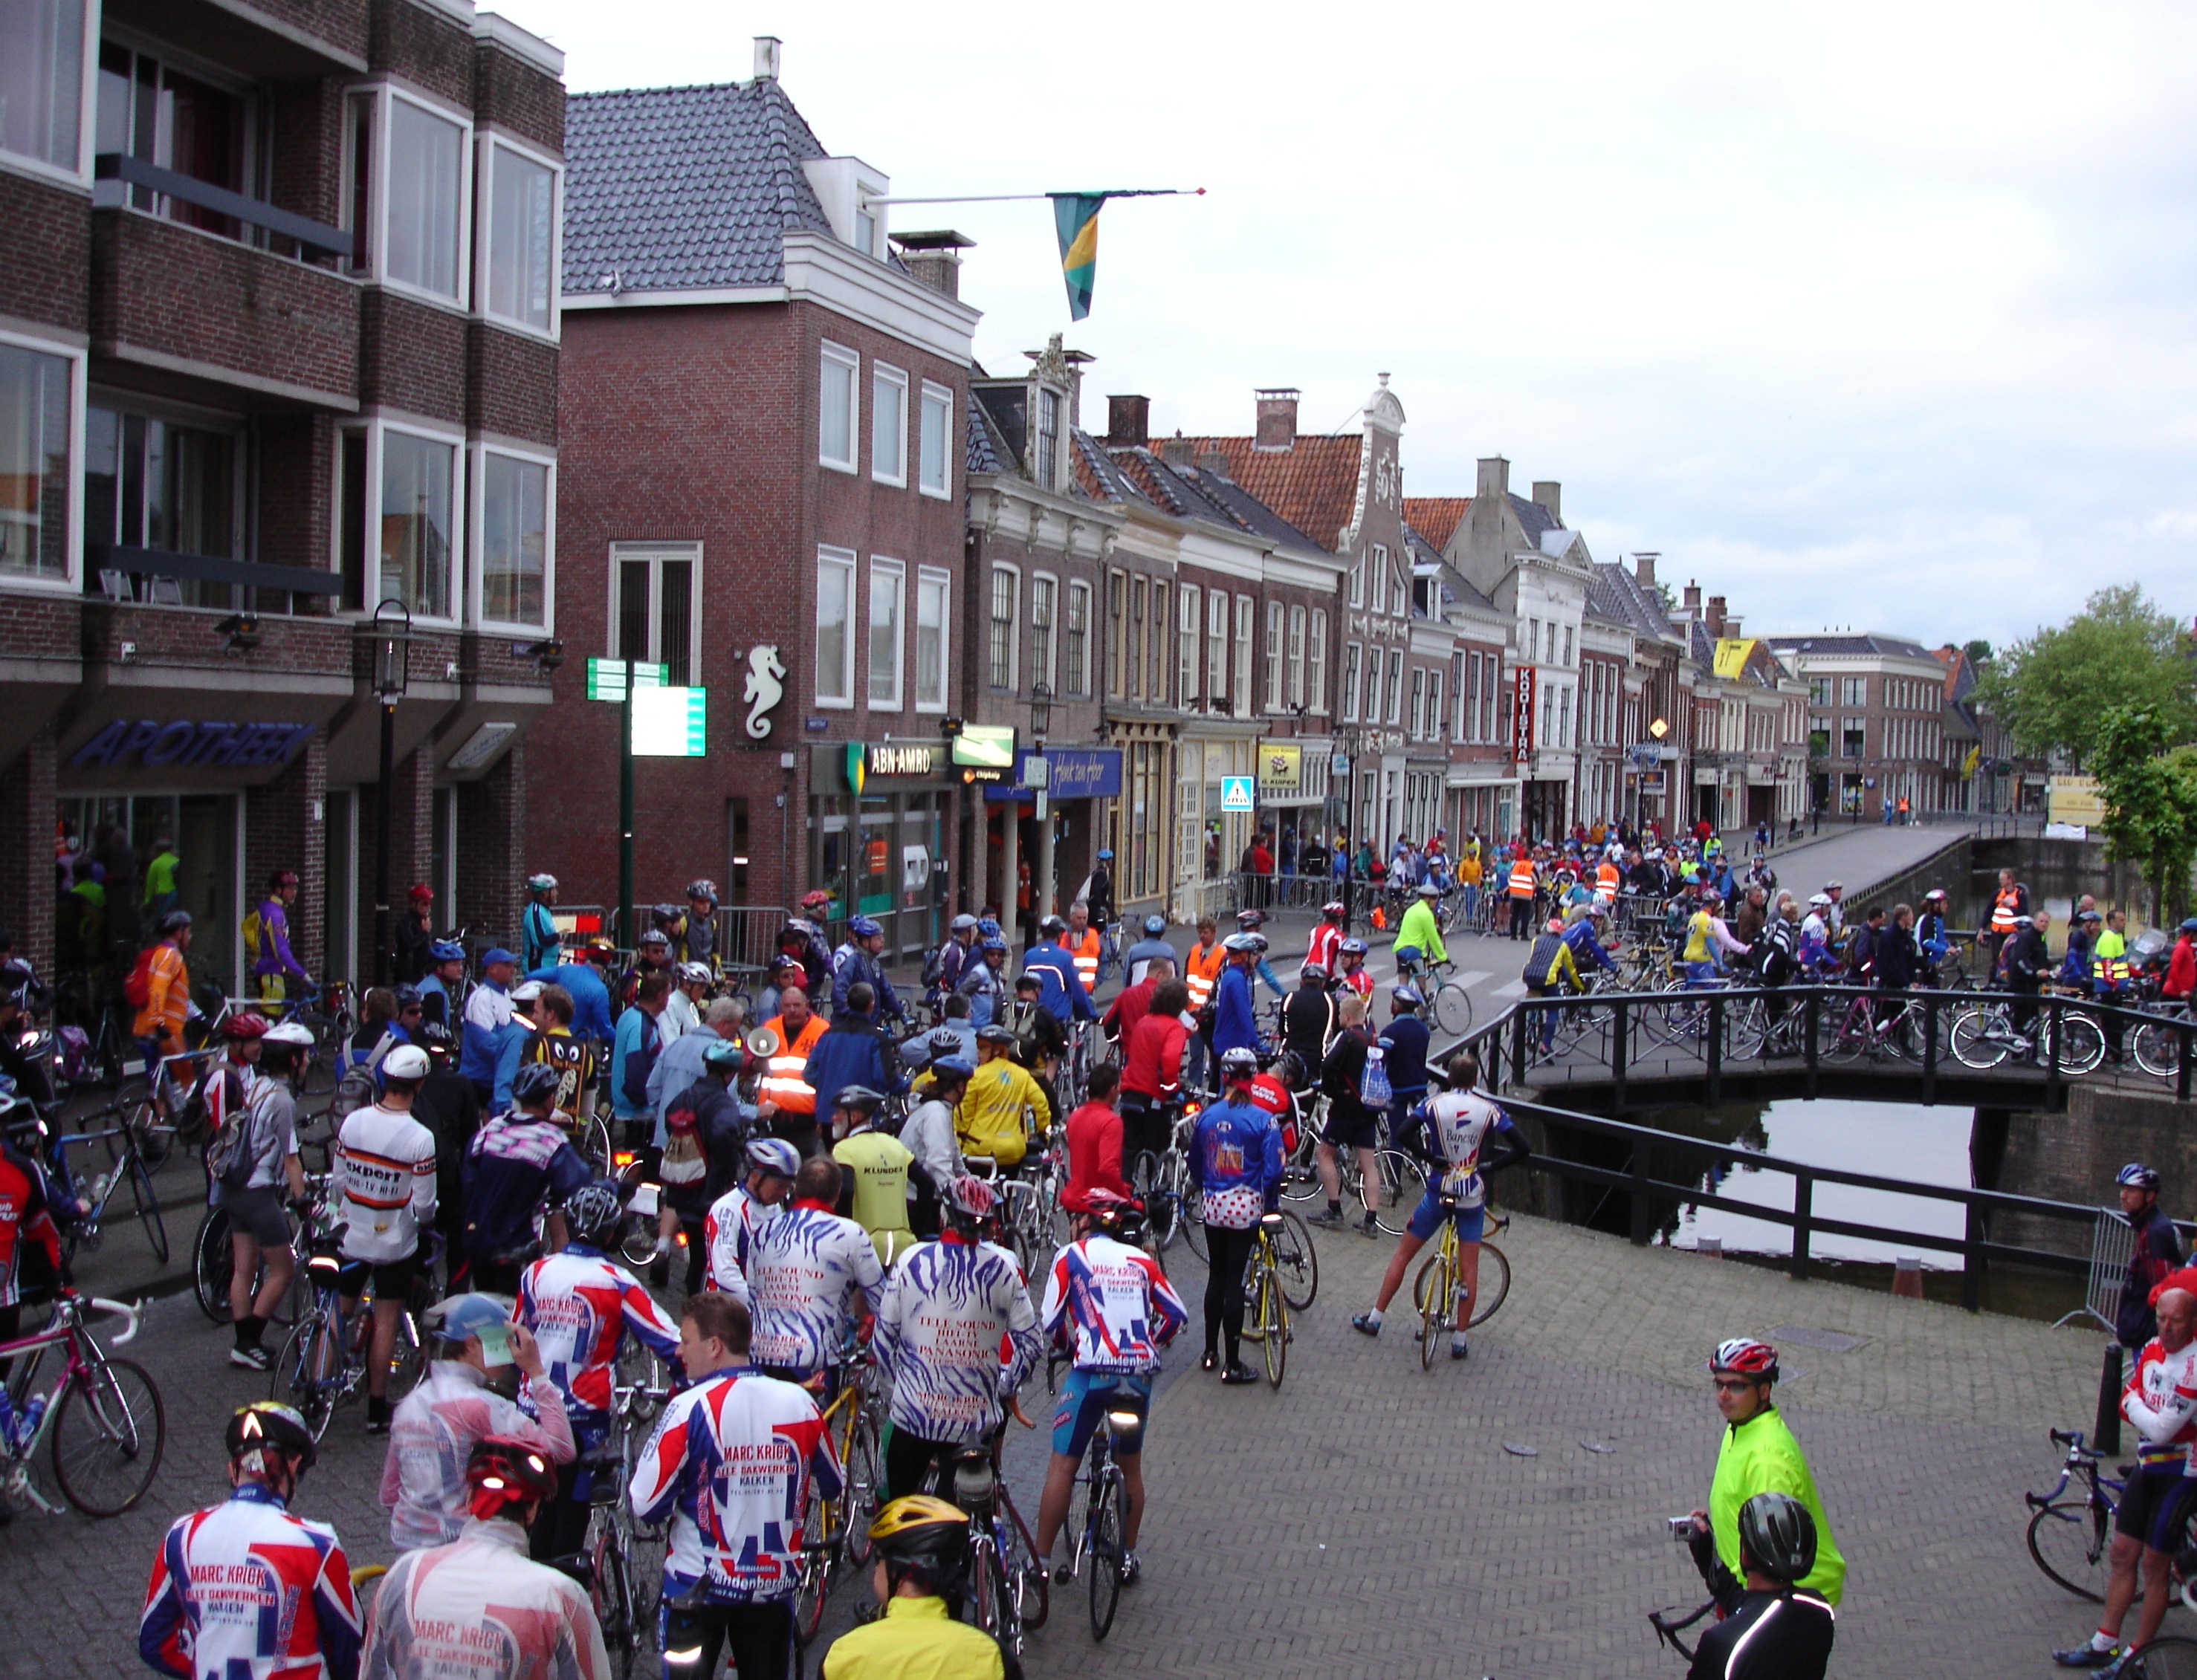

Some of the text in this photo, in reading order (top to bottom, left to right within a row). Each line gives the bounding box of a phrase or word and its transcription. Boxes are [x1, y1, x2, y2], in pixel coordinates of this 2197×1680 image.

[71, 719, 317, 766] APOTHEEK
[976, 770, 1000, 781] Chipknip
[346, 1161, 402, 1183] expert
[779, 1267, 824, 1280] SOUND
[920, 1316, 995, 1331] TELE SOUND
[936, 1337, 977, 1347] LAARNE
[919, 1346, 989, 1359] PANASONIC
[724, 1444, 754, 1462] MARC
[741, 1462, 796, 1476] DAKWERKEN
[740, 1475, 774, 1487] KALKEN
[190, 1566, 268, 1587] MARC KRICK
[209, 1589, 275, 1606] DAKWERKEN
[415, 1621, 502, 1654] MARC KRICK
